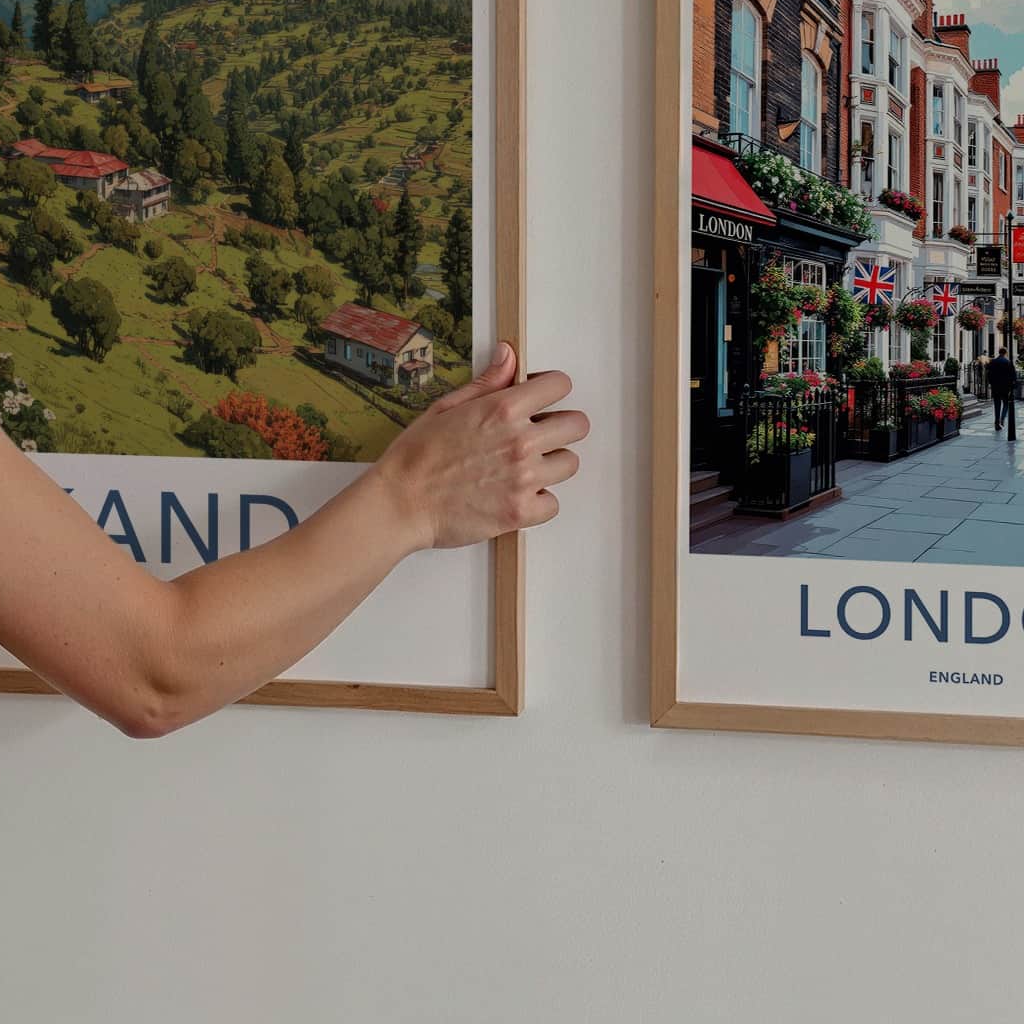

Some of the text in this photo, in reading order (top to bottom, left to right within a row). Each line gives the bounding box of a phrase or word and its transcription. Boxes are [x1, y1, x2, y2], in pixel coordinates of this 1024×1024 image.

[698, 213, 753, 242] LONDON
[799, 583, 1024, 645] LOND
[929, 671, 1004, 686] ENGLAND
